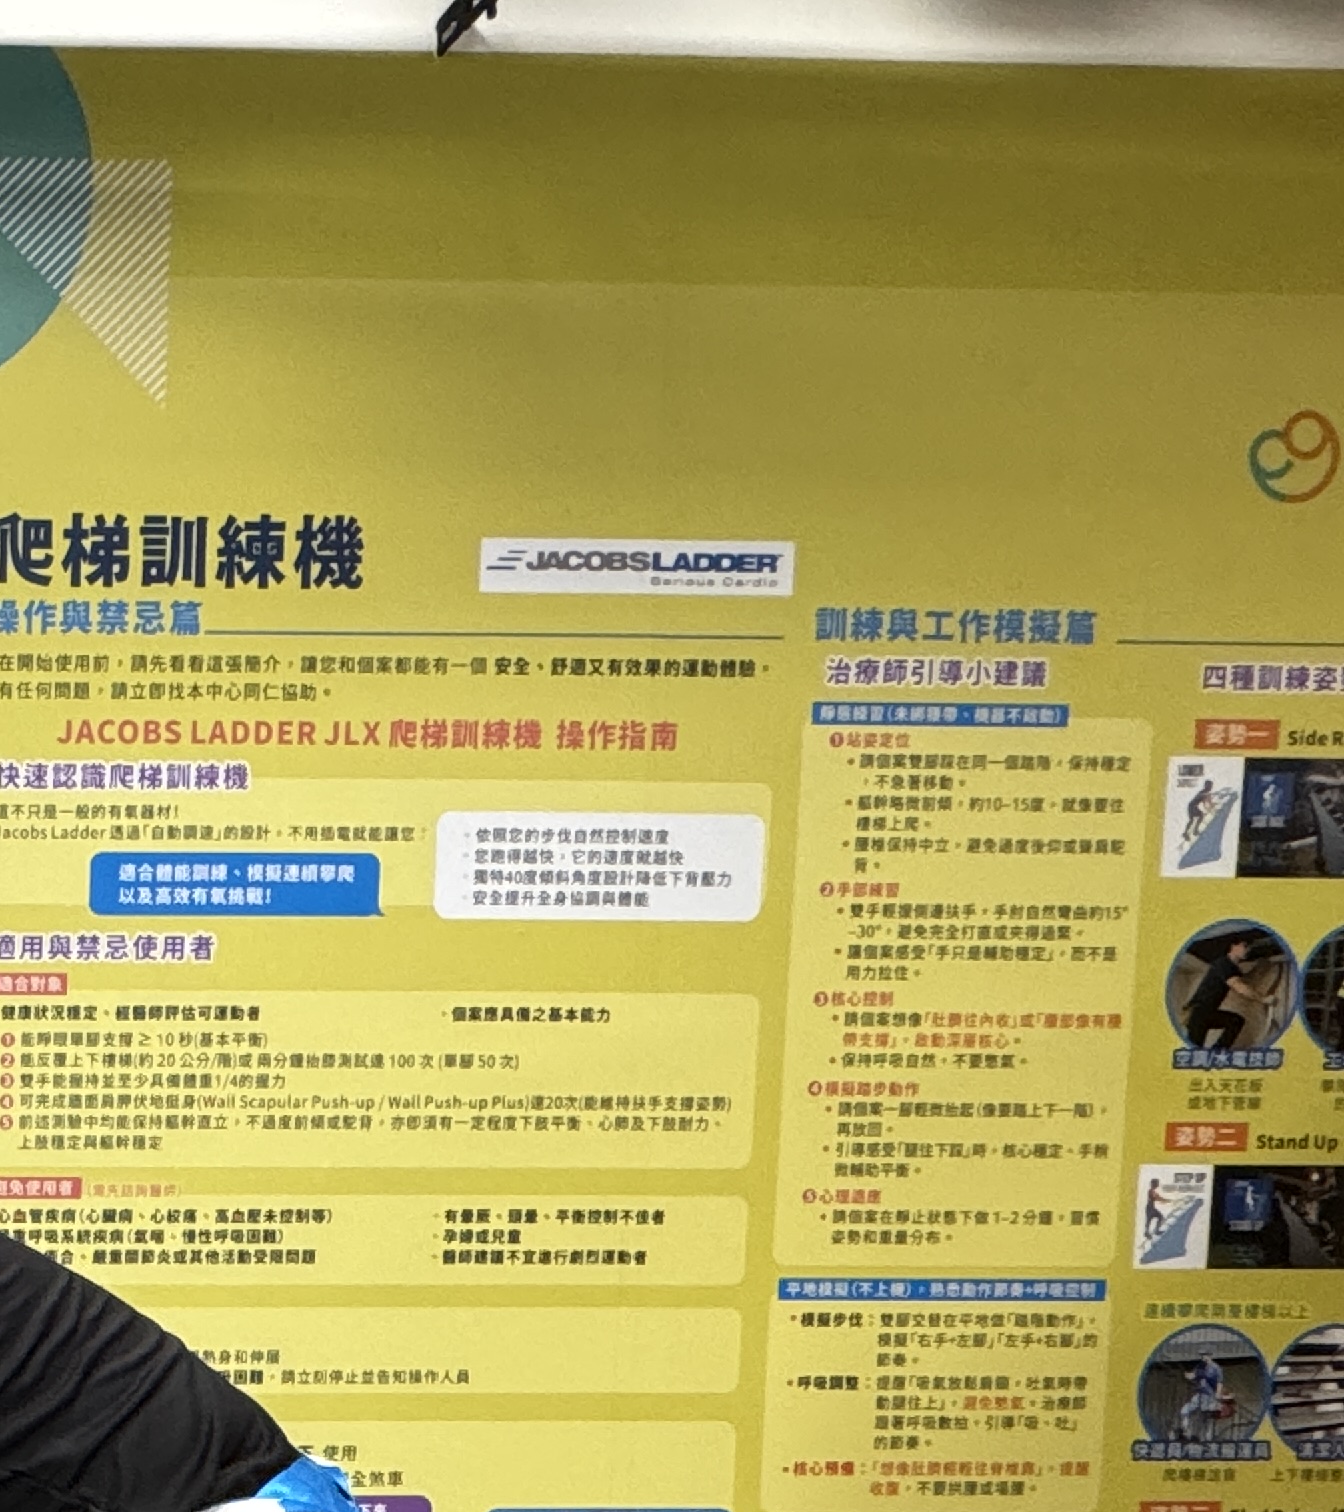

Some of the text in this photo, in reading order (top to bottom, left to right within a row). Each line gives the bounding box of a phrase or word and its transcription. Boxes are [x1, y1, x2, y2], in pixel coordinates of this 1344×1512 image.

[815, 607, 1098, 645] 訓練與工作模擬篇
[826, 658, 1047, 687] 治療師引導小建議
[1202, 664, 1344, 692] 四種訓練姿
[56, 718, 679, 751] JACOBS LADDER JLX 爬梯訓練機 操作指南
[1288, 728, 1327, 746] Side
[51, 825, 106, 841] Ladder
[157, 1033, 175, 1046] 10
[157, 1053, 176, 1067] 20
[389, 1054, 416, 1069] 100
[478, 1054, 496, 1069] 50
[239, 1095, 307, 1111] Scapular
[310, 1095, 375, 1112] Push-up
[388, 1096, 421, 1110] Wall
[424, 1096, 488, 1113] Push-up
[1256, 1133, 1309, 1150] Stand
[1314, 1133, 1338, 1154] Up
[323, 1445, 357, 1462] 使用
[345, 1471, 404, 1488] 全煞車
